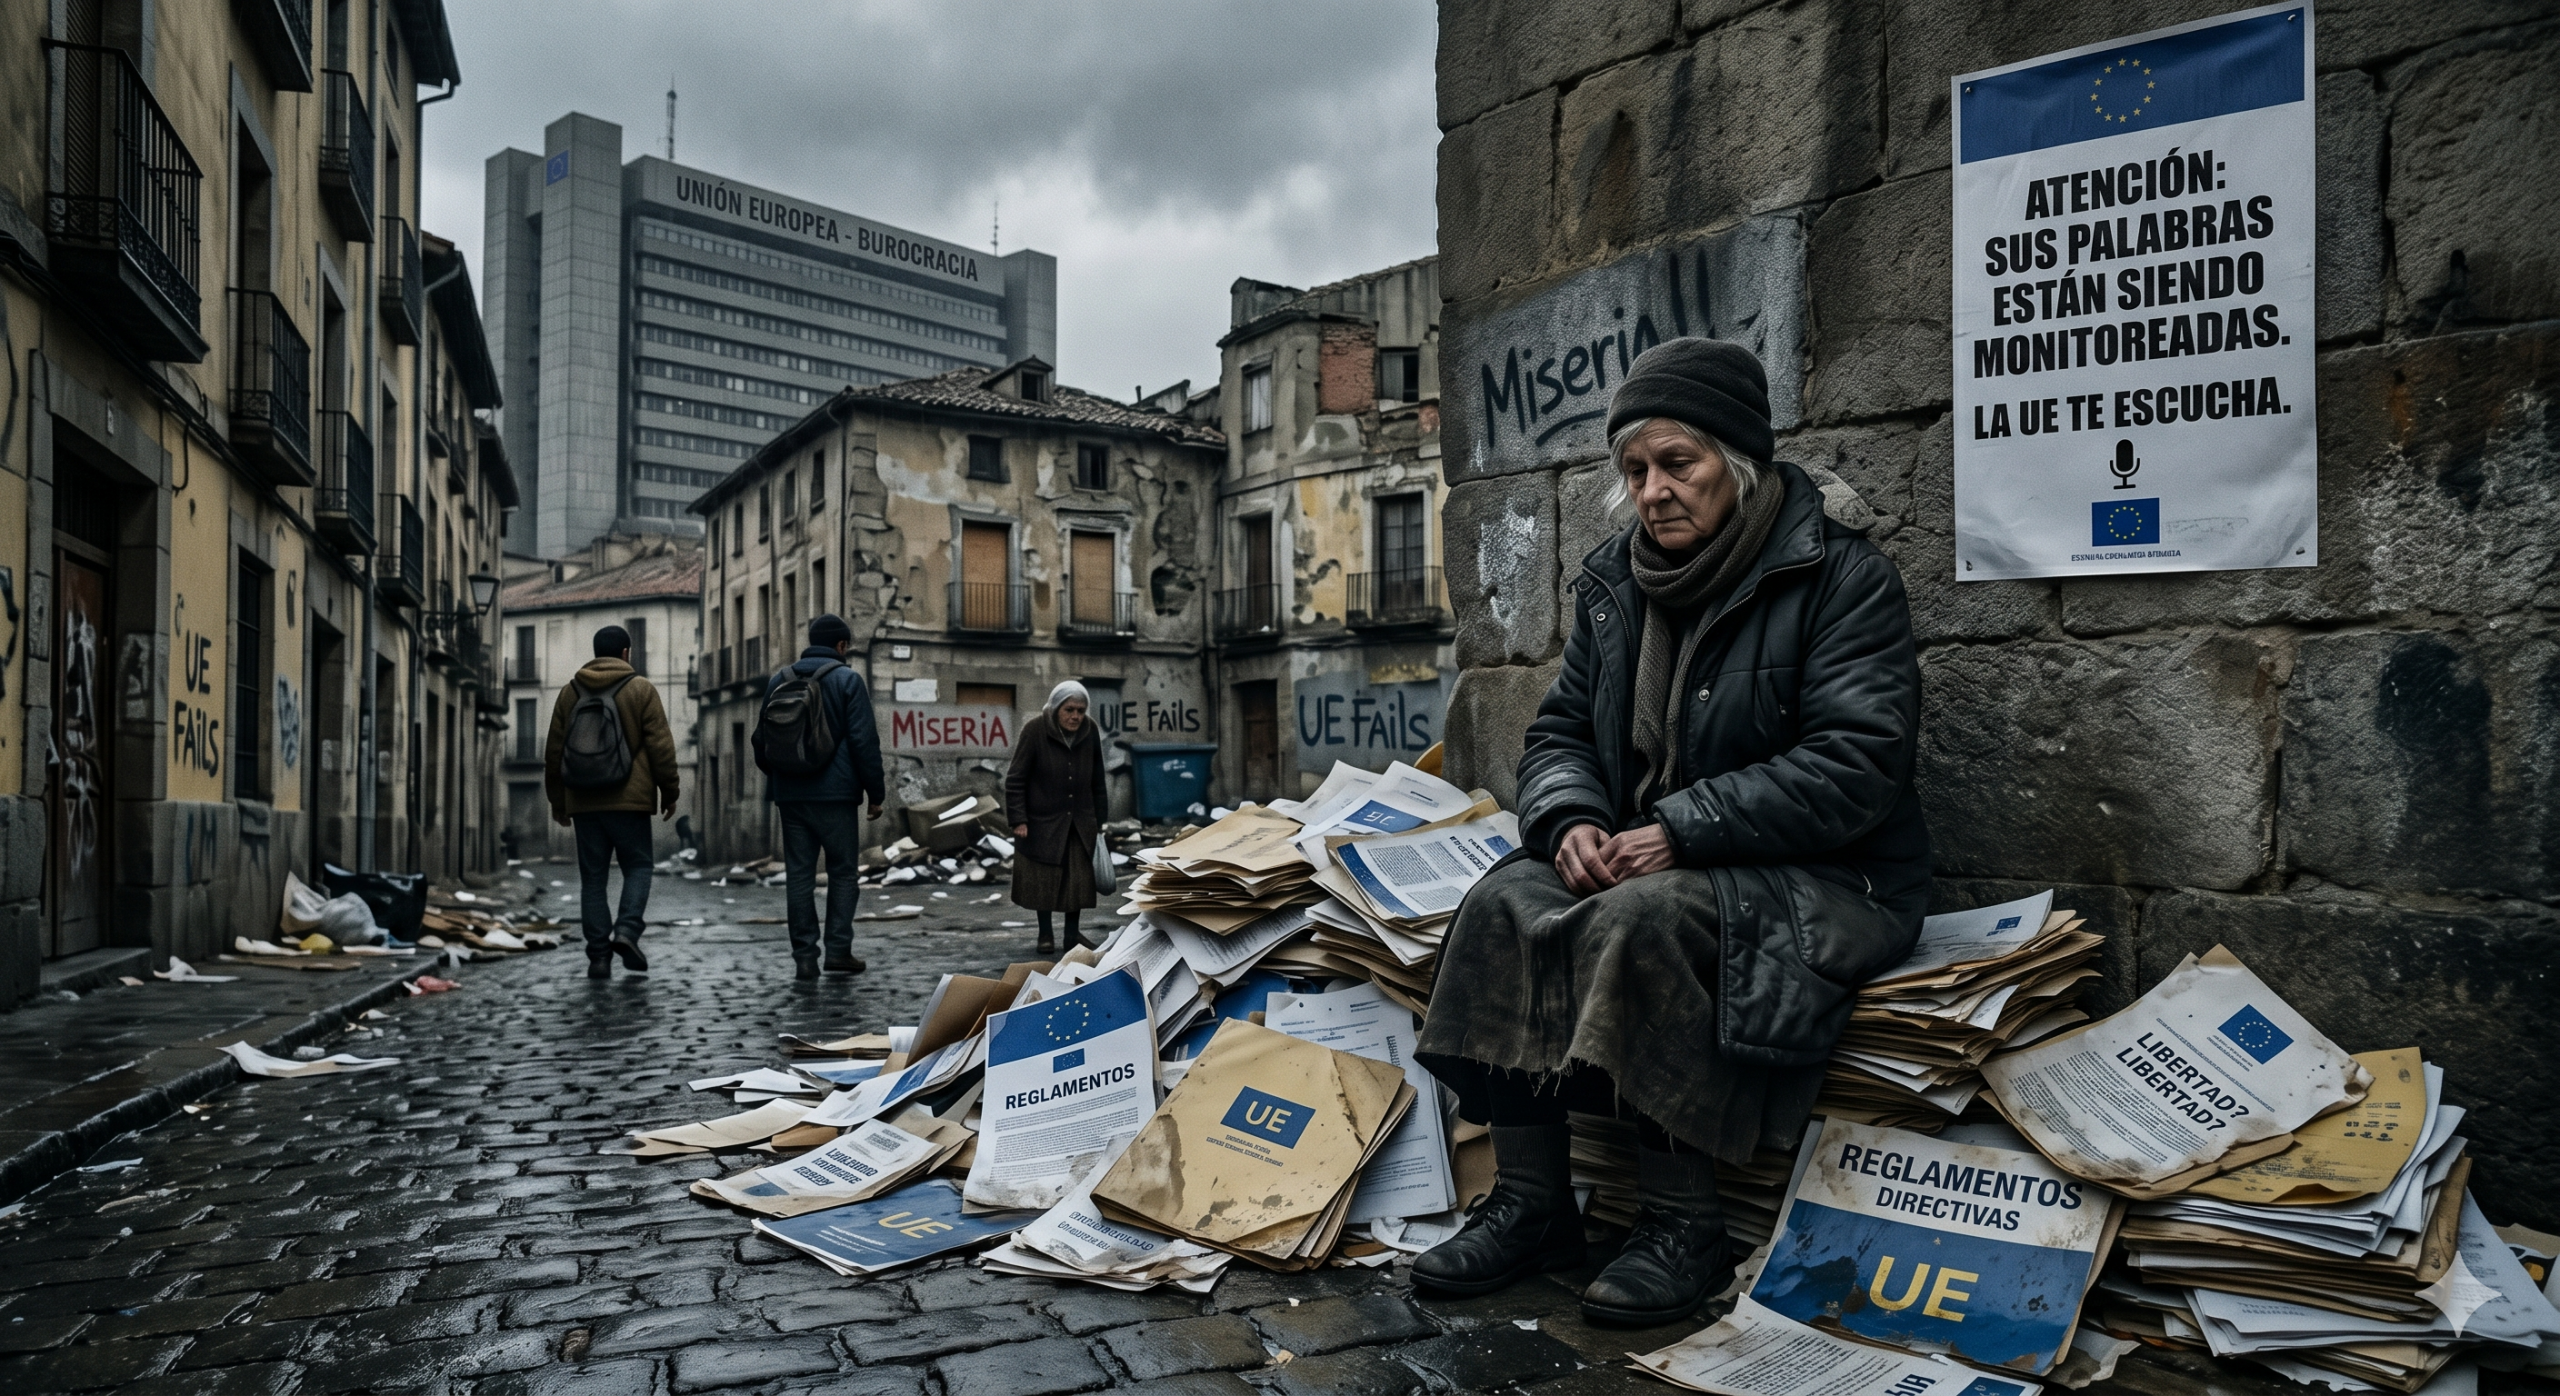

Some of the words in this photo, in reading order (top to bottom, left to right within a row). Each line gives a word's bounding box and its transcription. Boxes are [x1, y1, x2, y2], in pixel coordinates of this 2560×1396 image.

[2025, 146, 2226, 221] ATENCIÓN:
[675, 175, 742, 217] UNIÓN
[749, 196, 840, 244] EUROPEA
[858, 227, 978, 282] BUROCRACIA
[1985, 228, 2058, 277] SUS
[2068, 195, 2274, 265] PALABRAS
[1993, 269, 2106, 326] ESTÁN
[2117, 251, 2264, 311] SIENDO
[1974, 304, 2291, 379] MONITOREADAS.
[1974, 404, 2012, 440] LA
[2019, 398, 2059, 436] UE
[2066, 394, 2105, 431] TE
[2114, 376, 2291, 428] ESCUCHA.
[185, 629, 211, 695] UE
[1299, 694, 1346, 748] UE
[1005, 1062, 1136, 1111] REGLAMENTOS
[2115, 1046, 2227, 1132] LIBERTAD?
[2136, 1031, 2250, 1119] LIBERTAD?
[1245, 1100, 1293, 1134] UE
[1838, 1143, 2084, 1211] REGLAMENTOS
[1876, 1186, 2021, 1232] DIRECTIVAS
[878, 1211, 954, 1239] UE
[1869, 1255, 1980, 1323] UE
